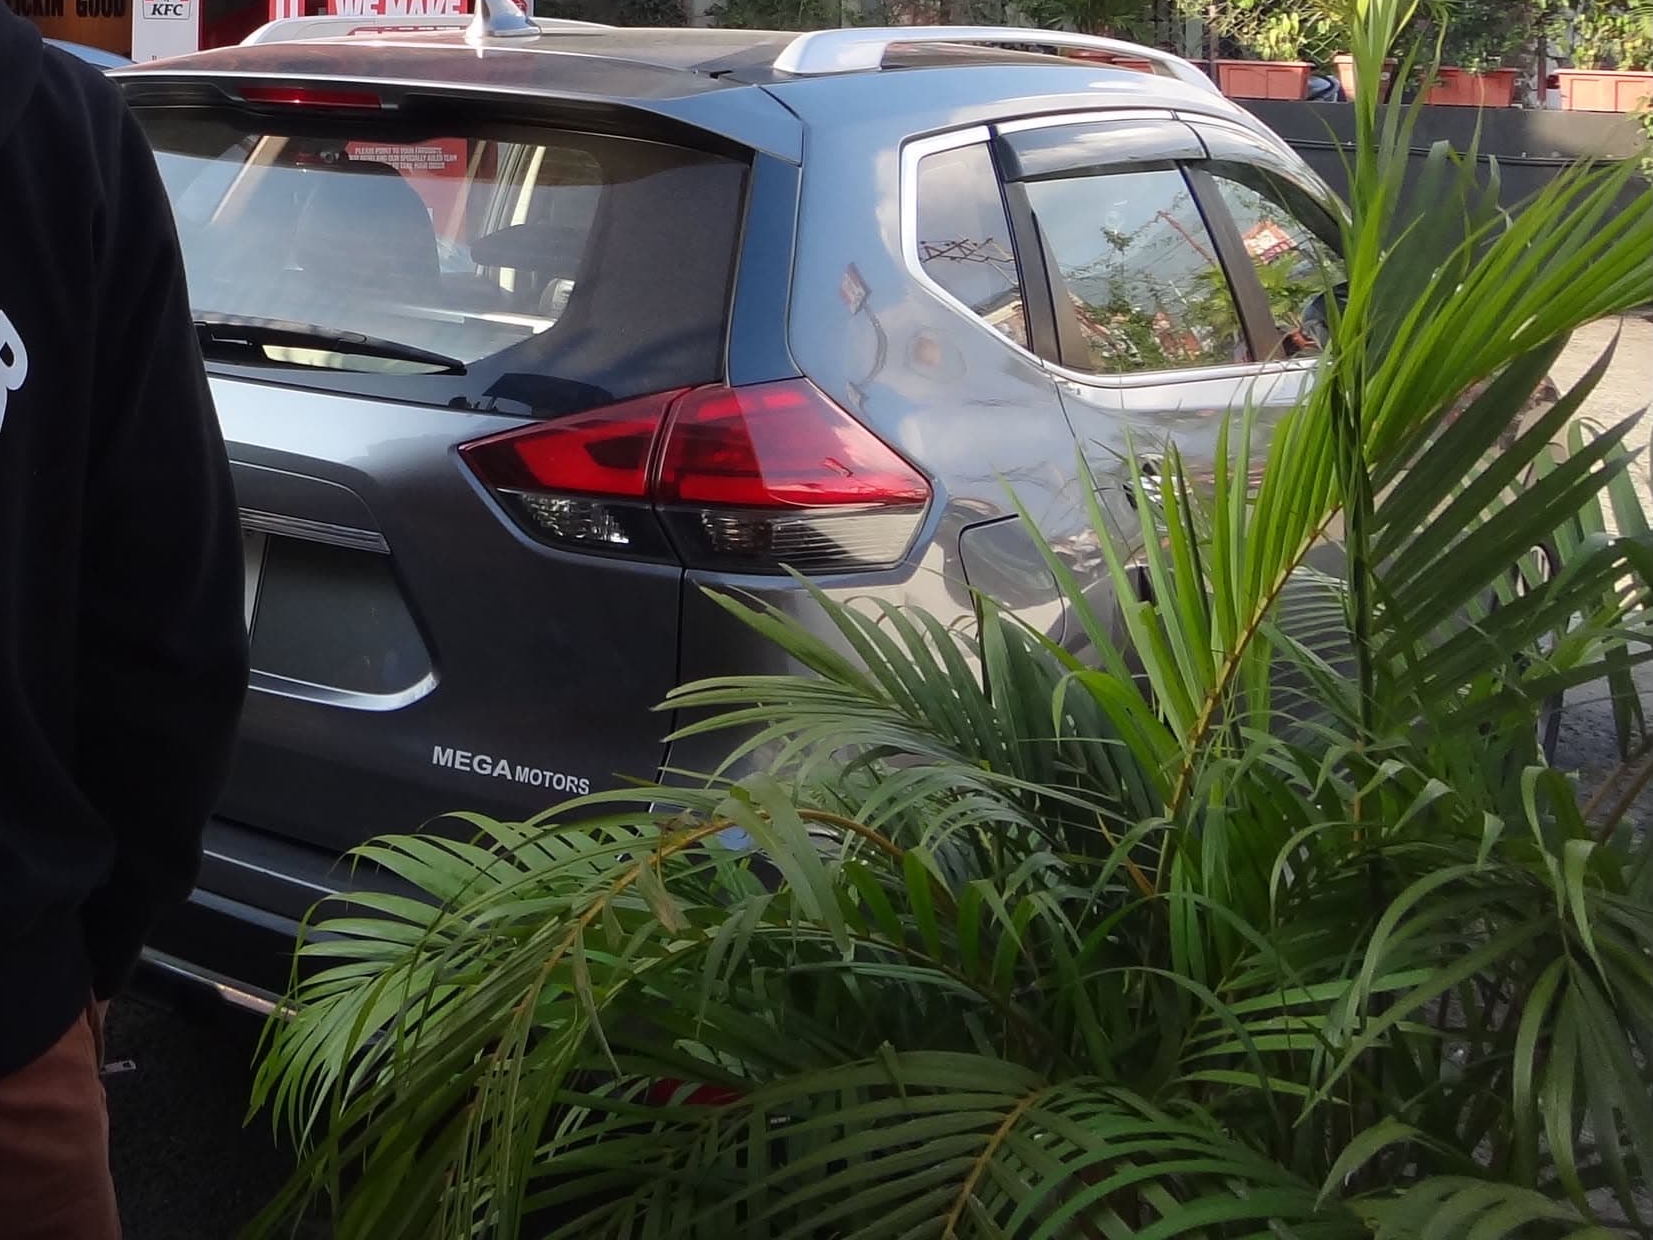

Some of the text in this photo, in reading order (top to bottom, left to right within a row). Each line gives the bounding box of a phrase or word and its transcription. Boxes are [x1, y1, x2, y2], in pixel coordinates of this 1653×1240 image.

[151, 3, 183, 16] KFC
[432, 745, 590, 795] MEGA MOTORS
